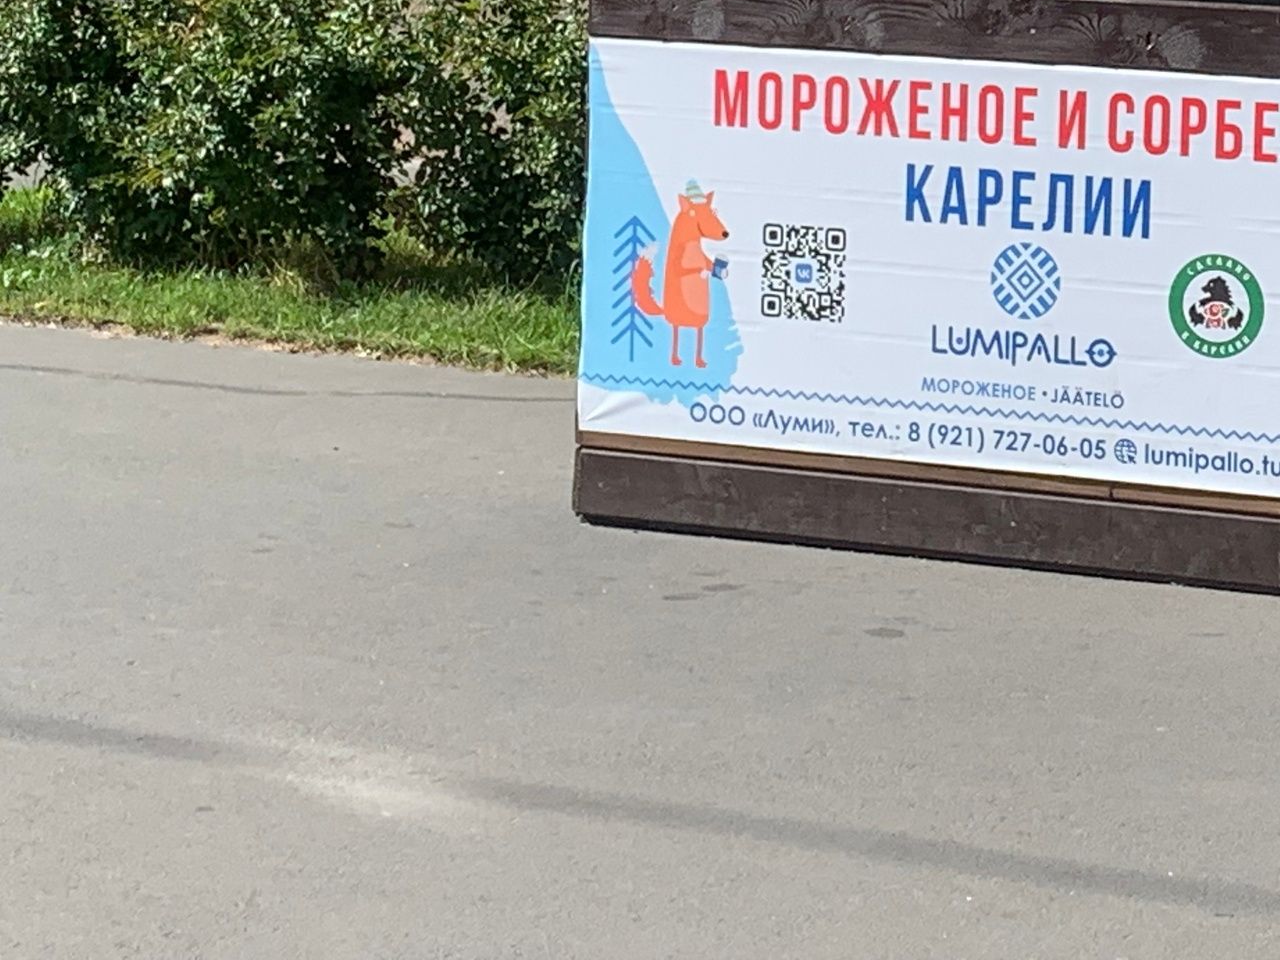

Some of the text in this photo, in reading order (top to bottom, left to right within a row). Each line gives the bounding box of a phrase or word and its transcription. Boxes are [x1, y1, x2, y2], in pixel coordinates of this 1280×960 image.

[713, 69, 1038, 148] МОРОЖЕНОЕ
[1059, 89, 1087, 150] И
[905, 163, 1152, 239] КАРЕЛИИ
[932, 324, 1117, 367] LUMIPALLO
[921, 376, 1036, 401] МОРОЖЕНОЕ
[1051, 385, 1124, 409] JÄÄTELÖ
[690, 402, 745, 426] ООО
[753, 409, 840, 437] «Луми»,
[849, 421, 900, 441] тел.:
[908, 422, 920, 442] 8
[928, 422, 985, 453] (921)
[993, 430, 1107, 460] 727-06-05
